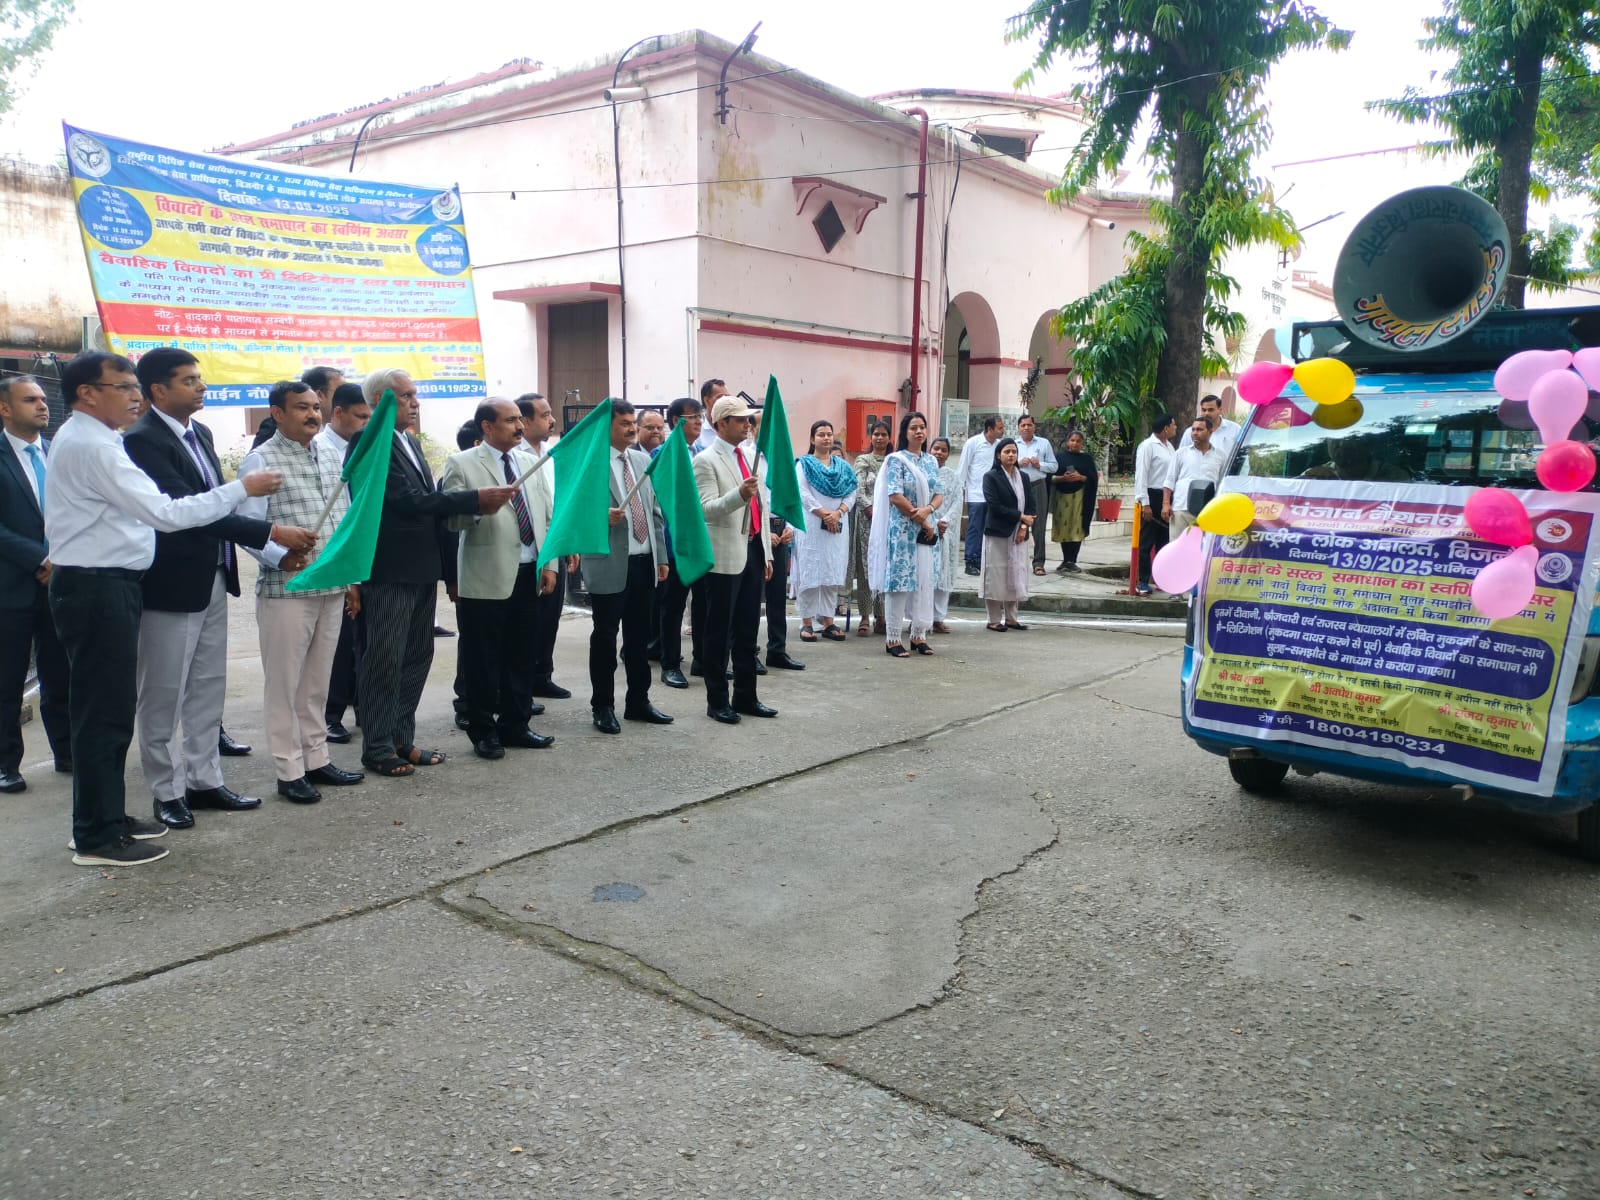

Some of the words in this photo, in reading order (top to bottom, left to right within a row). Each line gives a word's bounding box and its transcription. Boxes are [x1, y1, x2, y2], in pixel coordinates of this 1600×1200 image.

[1290, 502, 1363, 520] पंजाब
[1250, 528, 1303, 549] राष्ट्रीय
[1311, 531, 1357, 548] लोक
[1221, 560, 1265, 575] विवादों
[1265, 564, 1282, 576] के
[1286, 567, 1324, 581] सरल
[1332, 572, 1398, 589] समाधान
[1401, 579, 1426, 592] का
[1433, 562, 1481, 576] शनिवा
[1333, 587, 1347, 597] का
[1352, 589, 1393, 602] समाधान
[1295, 594, 1328, 607] राष्ट्रीय
[1333, 597, 1356, 610] लोक
[1361, 603, 1399, 616] अदालत
[1422, 607, 1449, 622] किया
[1395, 627, 1407, 639] में
[1479, 638, 1492, 650] के
[1328, 650, 1339, 661] के
[1340, 655, 1373, 667] माध्यम
[1374, 657, 1384, 669] से
[1424, 646, 1460, 662] विवादों
[1458, 653, 1475, 665] का
[1476, 656, 1522, 674] समाधान
[1487, 714, 1519, 730] कुमार
[1305, 718, 1446, 754] 18004190234
